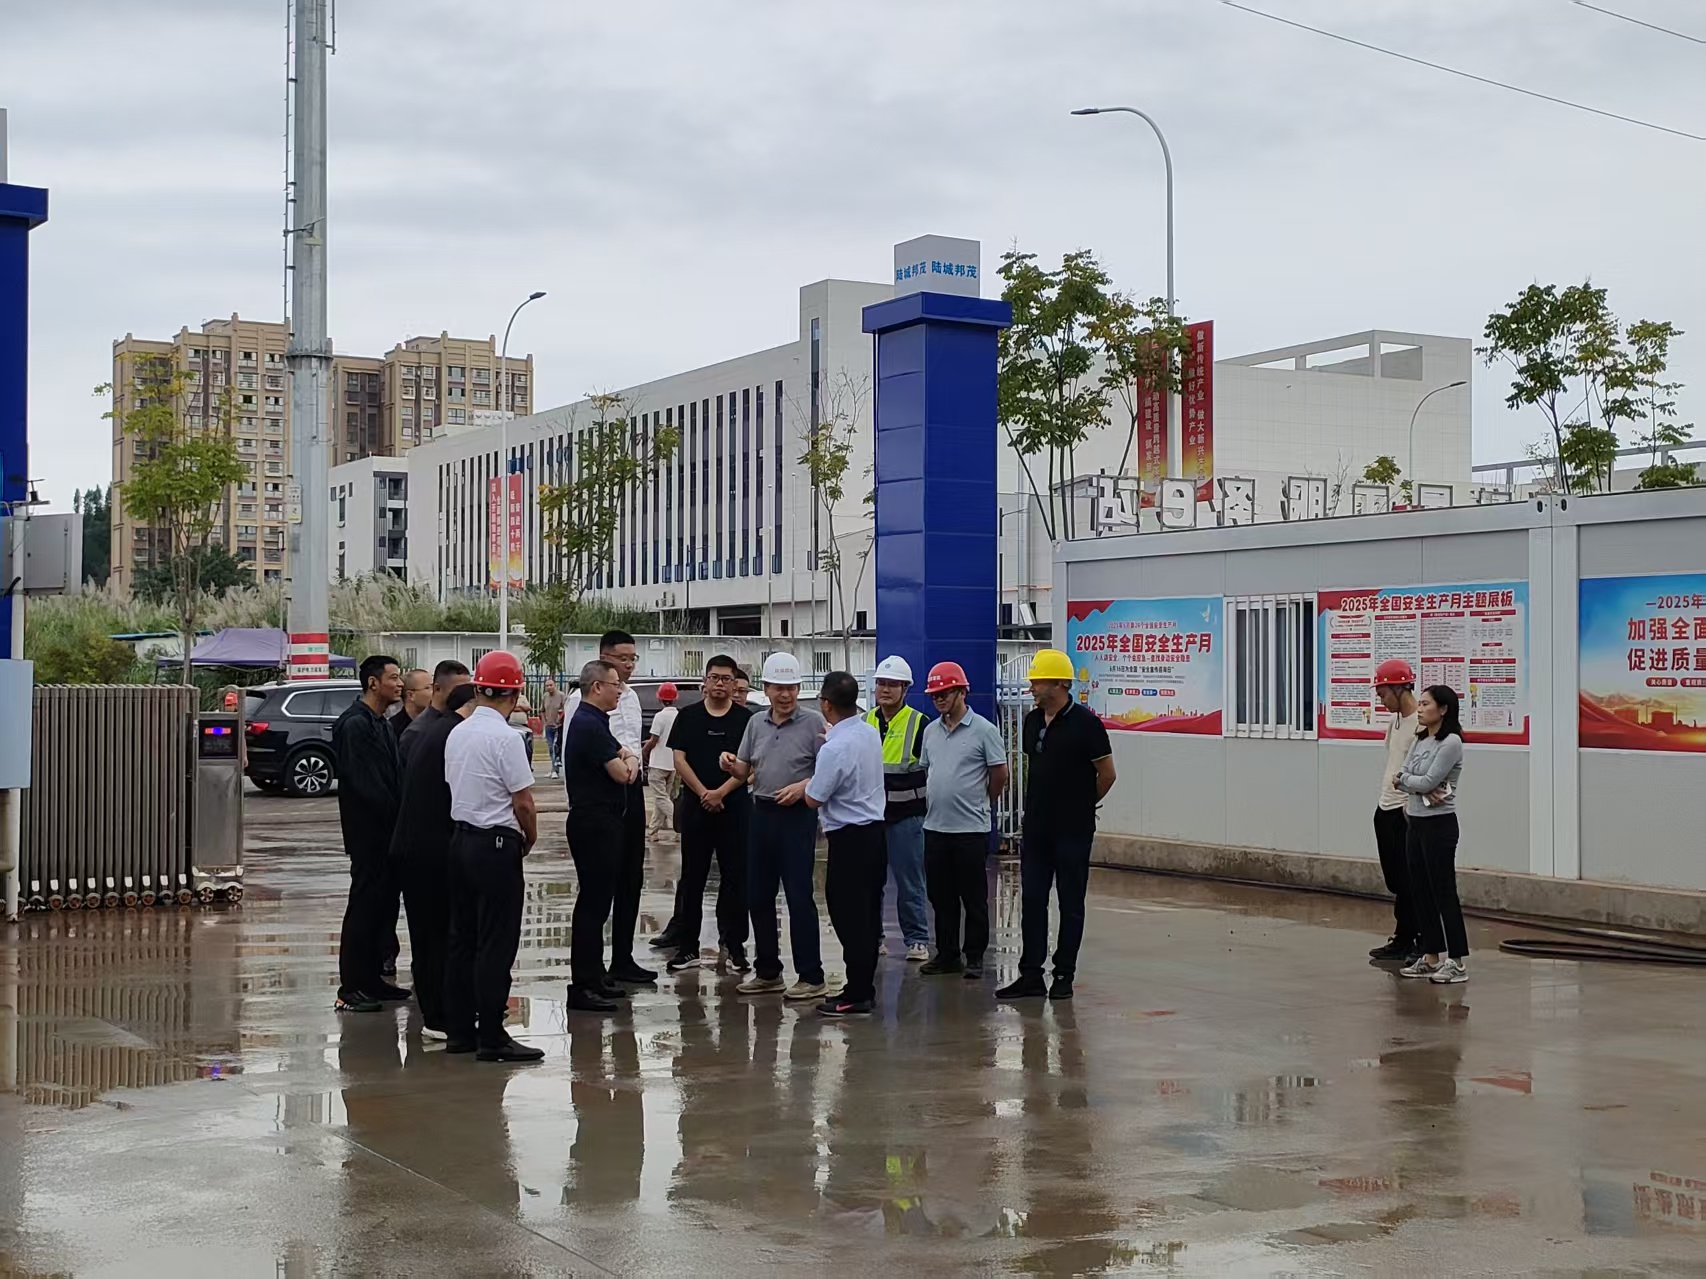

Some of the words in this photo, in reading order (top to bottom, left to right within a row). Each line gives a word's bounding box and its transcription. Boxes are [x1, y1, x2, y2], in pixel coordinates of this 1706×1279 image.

[896, 262, 927, 281] 陆城邦茂
[931, 260, 977, 278] 陆城邦茂
[1341, 590, 1513, 612] 2025年全国安全生产月主题展板
[1076, 633, 1212, 654] 2025年全国安全生产月
